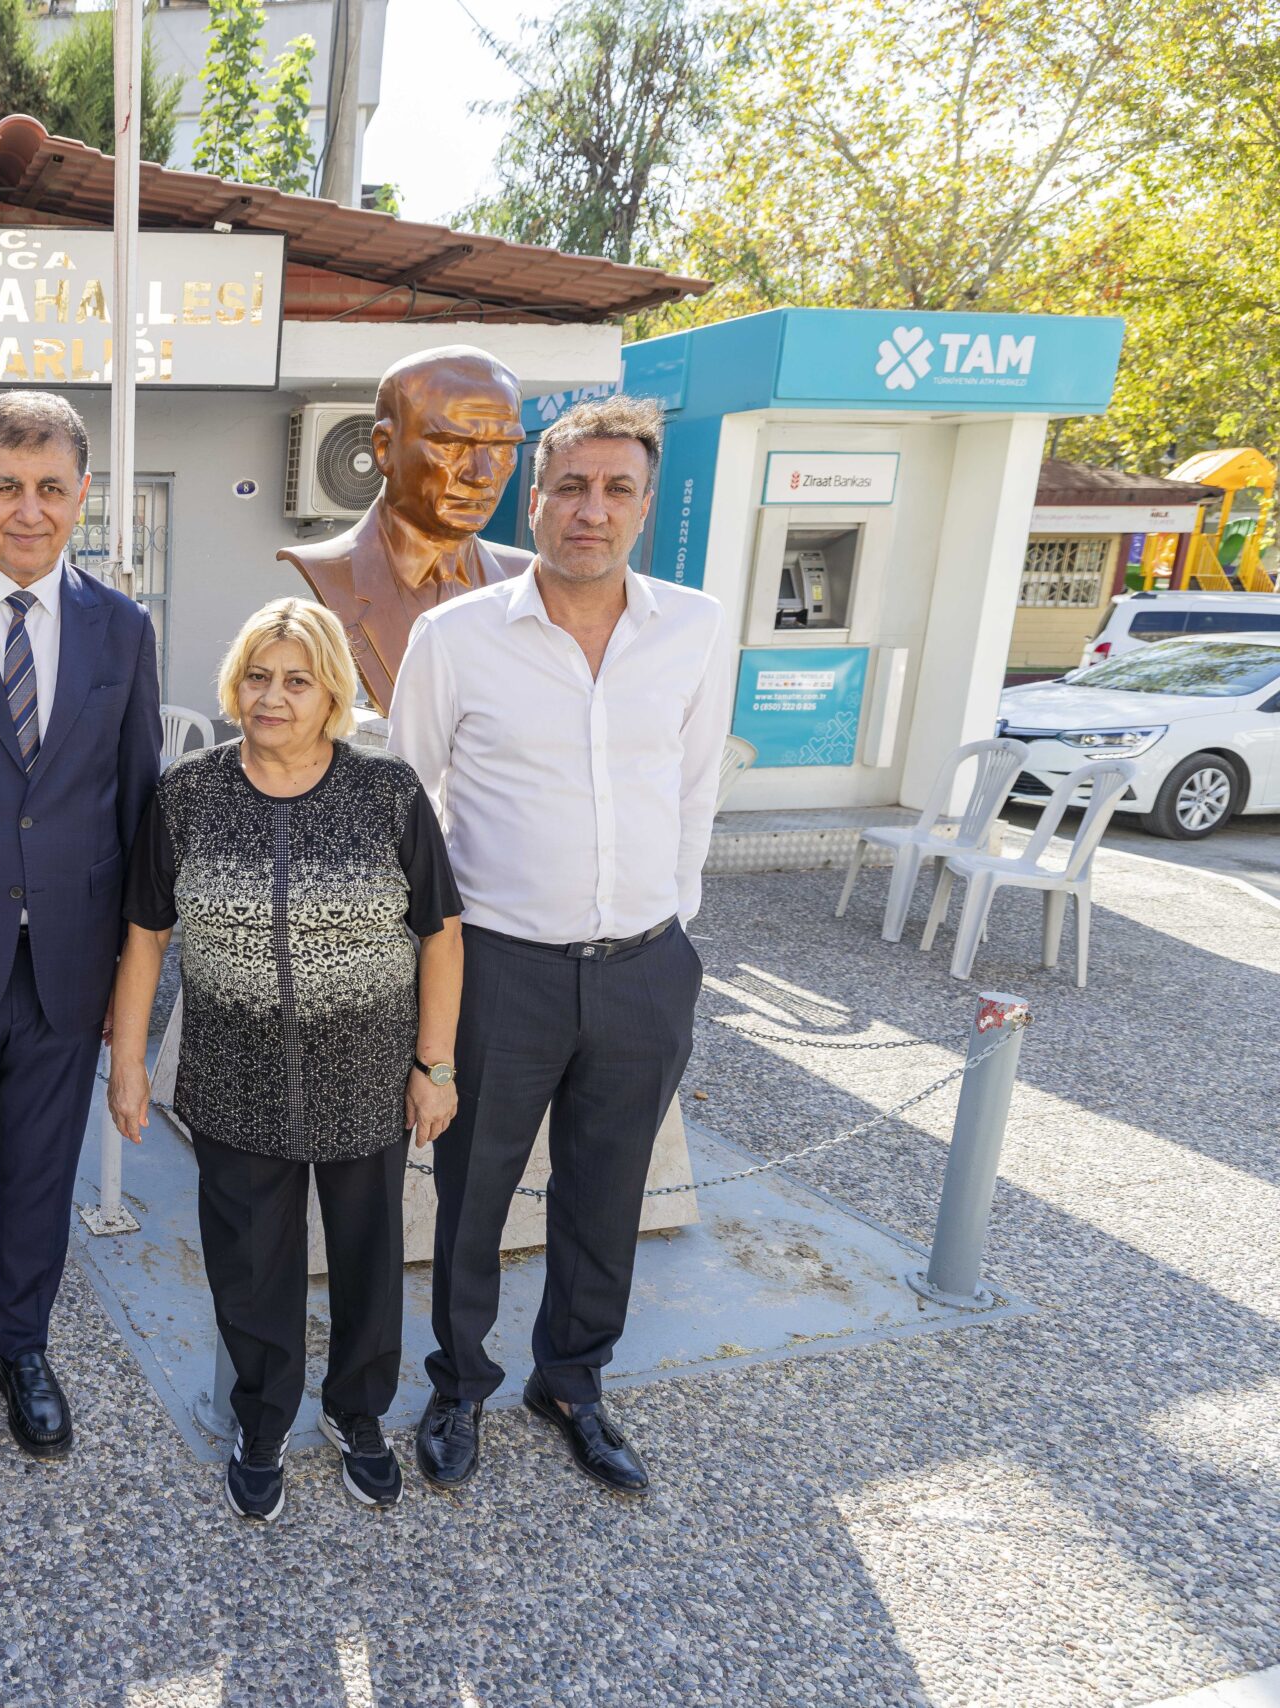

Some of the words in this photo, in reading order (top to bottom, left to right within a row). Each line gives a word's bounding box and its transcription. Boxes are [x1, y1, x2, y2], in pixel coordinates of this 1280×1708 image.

[939, 333, 1036, 375] TAM
[683, 479, 693, 504] 826
[802, 475, 832, 487] Ziraat
[679, 520, 689, 543] 222
